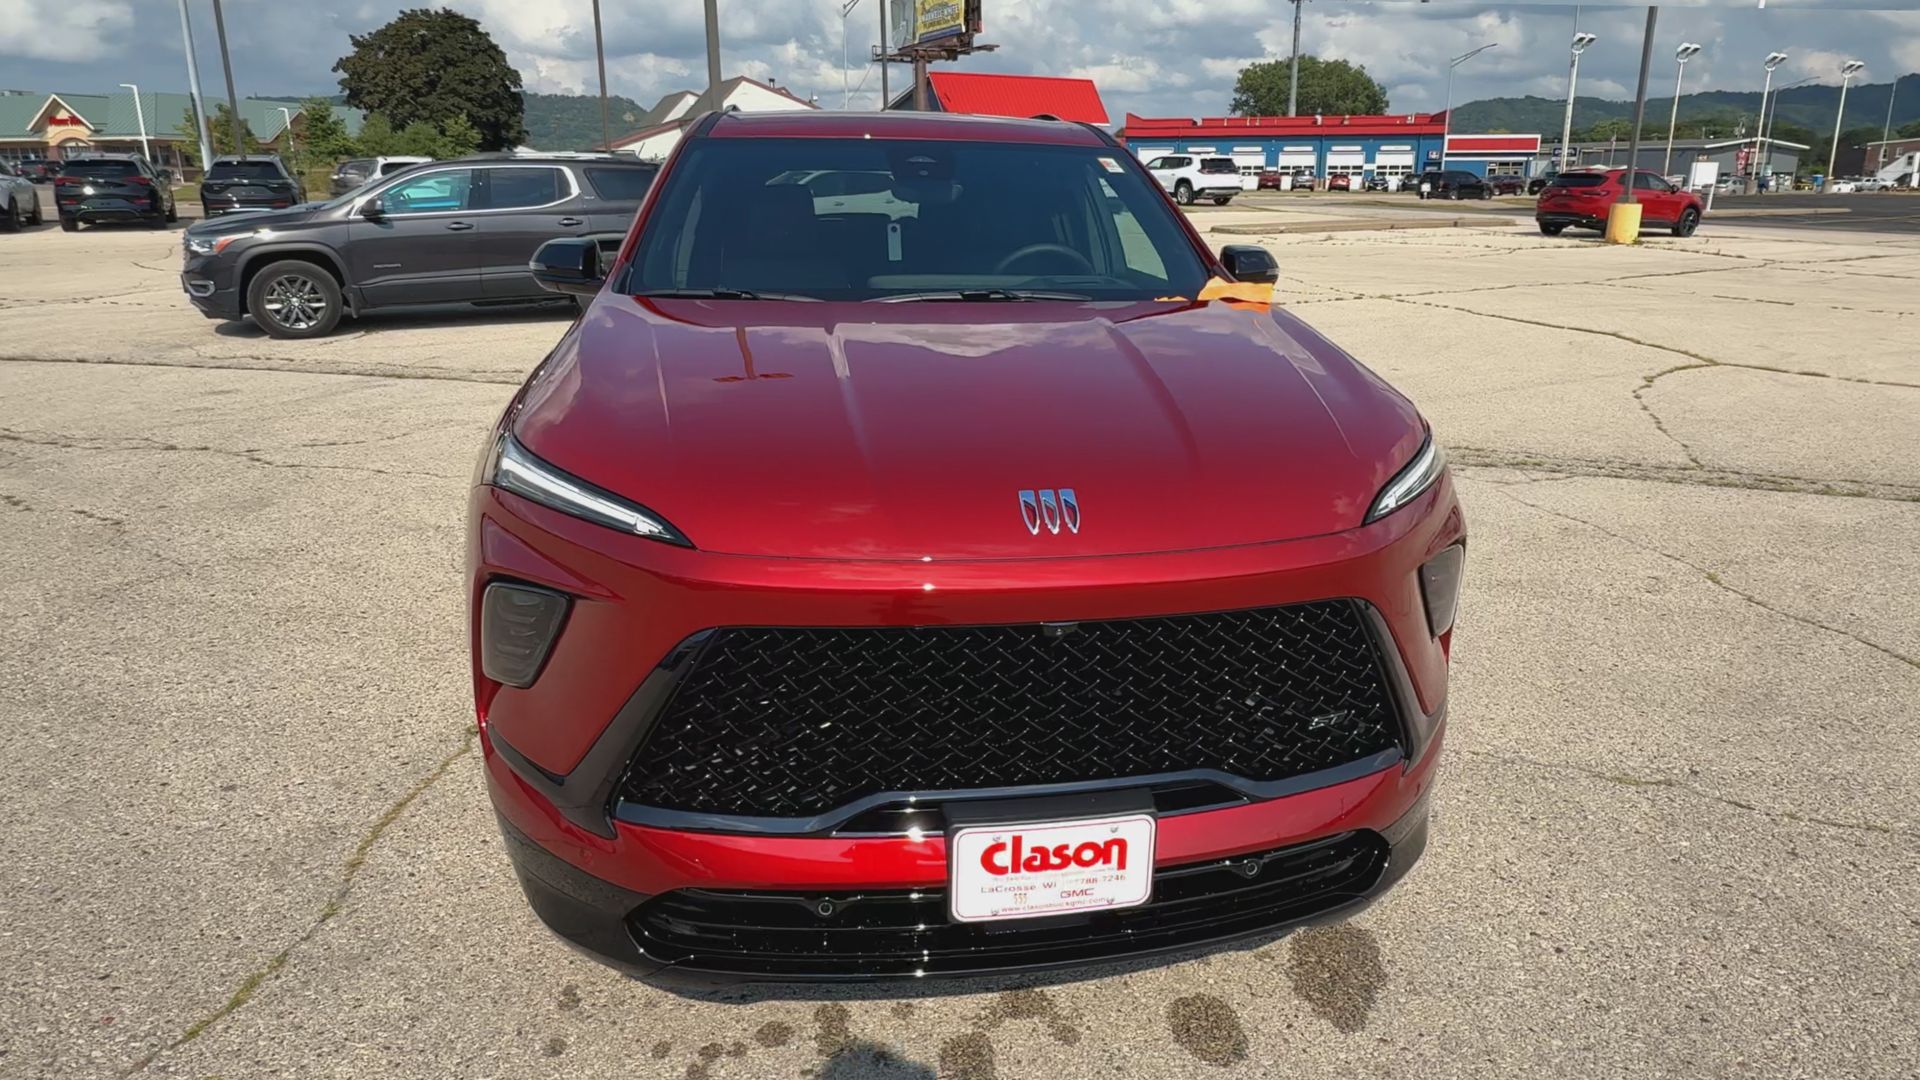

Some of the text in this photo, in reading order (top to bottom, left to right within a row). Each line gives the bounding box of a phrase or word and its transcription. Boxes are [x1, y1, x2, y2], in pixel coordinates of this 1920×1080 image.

[980, 835, 1128, 876] Clason
[981, 885, 1037, 894] LaCrosse
[1060, 888, 1095, 899] GMC
